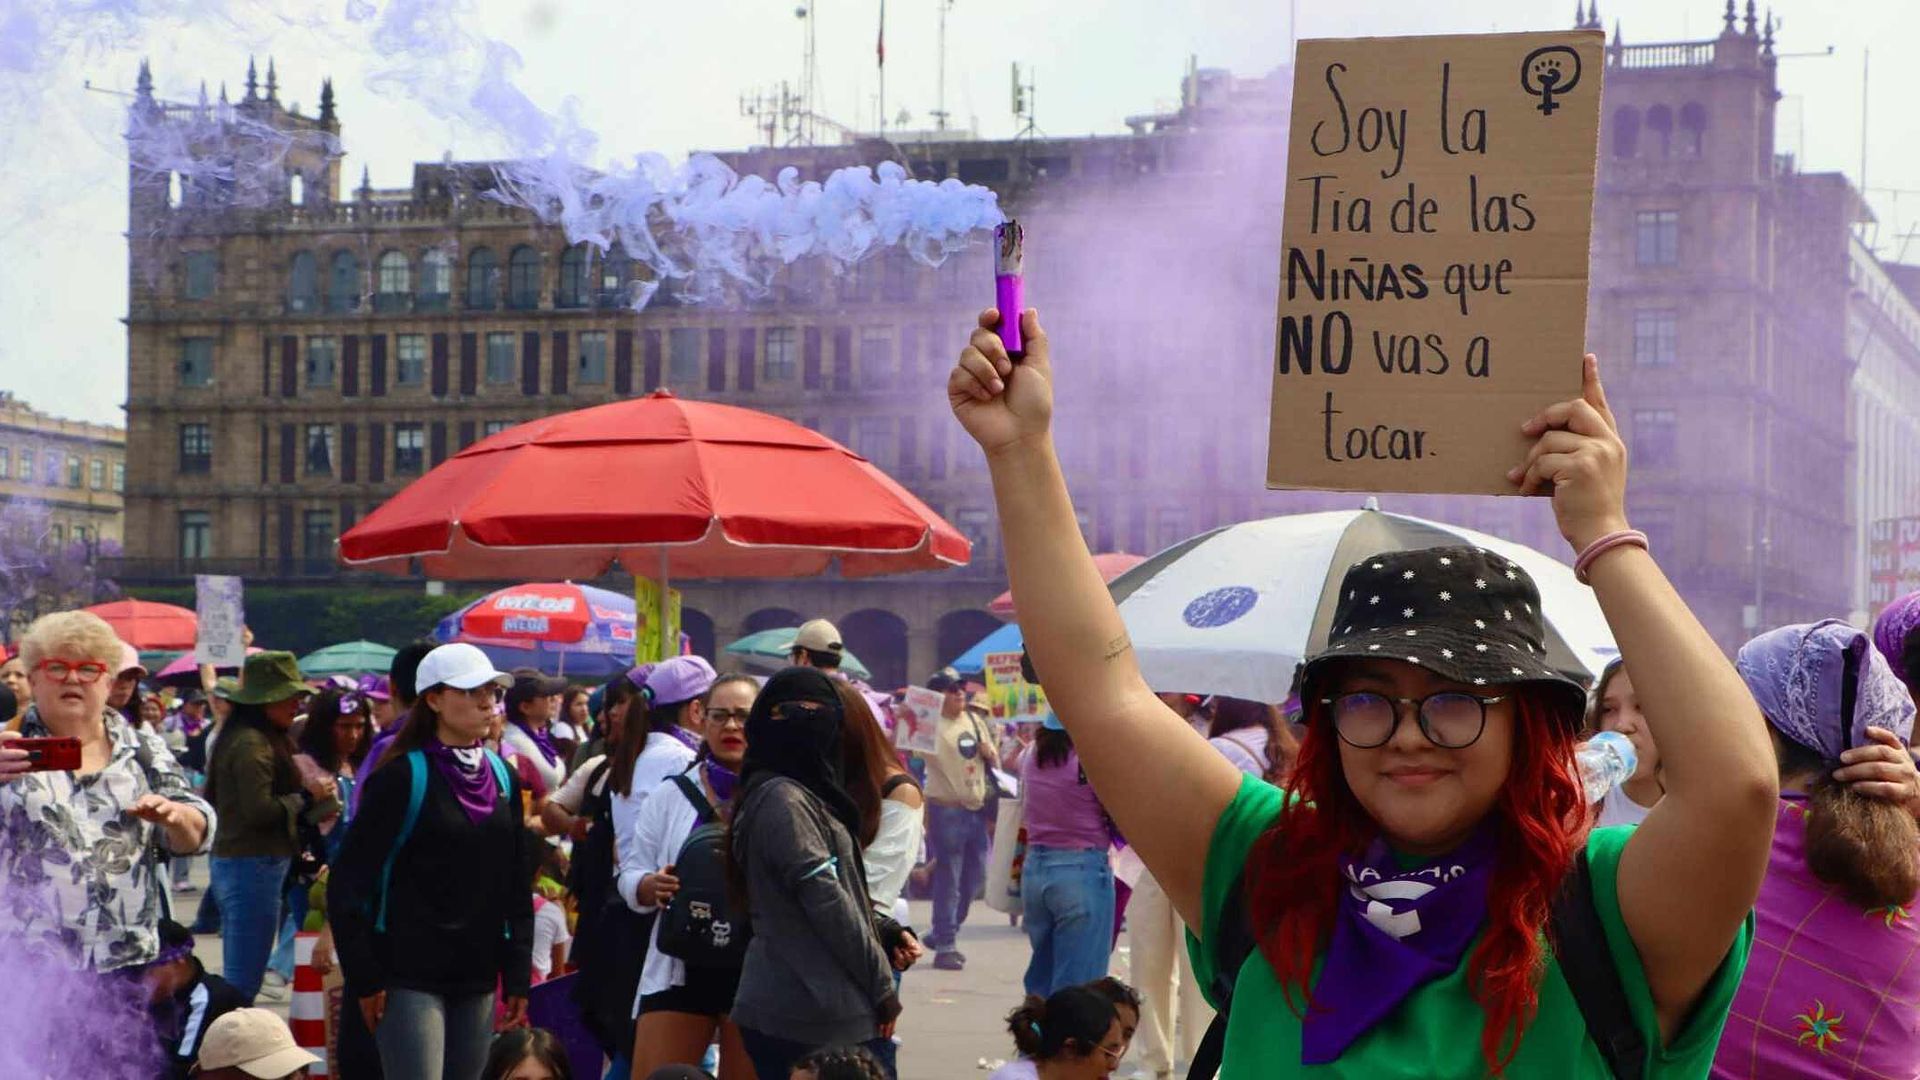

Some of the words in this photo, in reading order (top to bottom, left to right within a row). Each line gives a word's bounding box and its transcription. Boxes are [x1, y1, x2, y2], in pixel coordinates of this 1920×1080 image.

[1311, 63, 1407, 178] Soy
[1441, 62, 1486, 154] la
[1390, 183, 1438, 233] de
[1470, 175, 1536, 232] las
[1444, 258, 1512, 315] que
[1279, 310, 1353, 375] NO
[1373, 330, 1449, 375] vas
[1465, 336, 1490, 377] a
[1321, 392, 1437, 462] tocar.
[504, 618, 547, 632] MEGA
